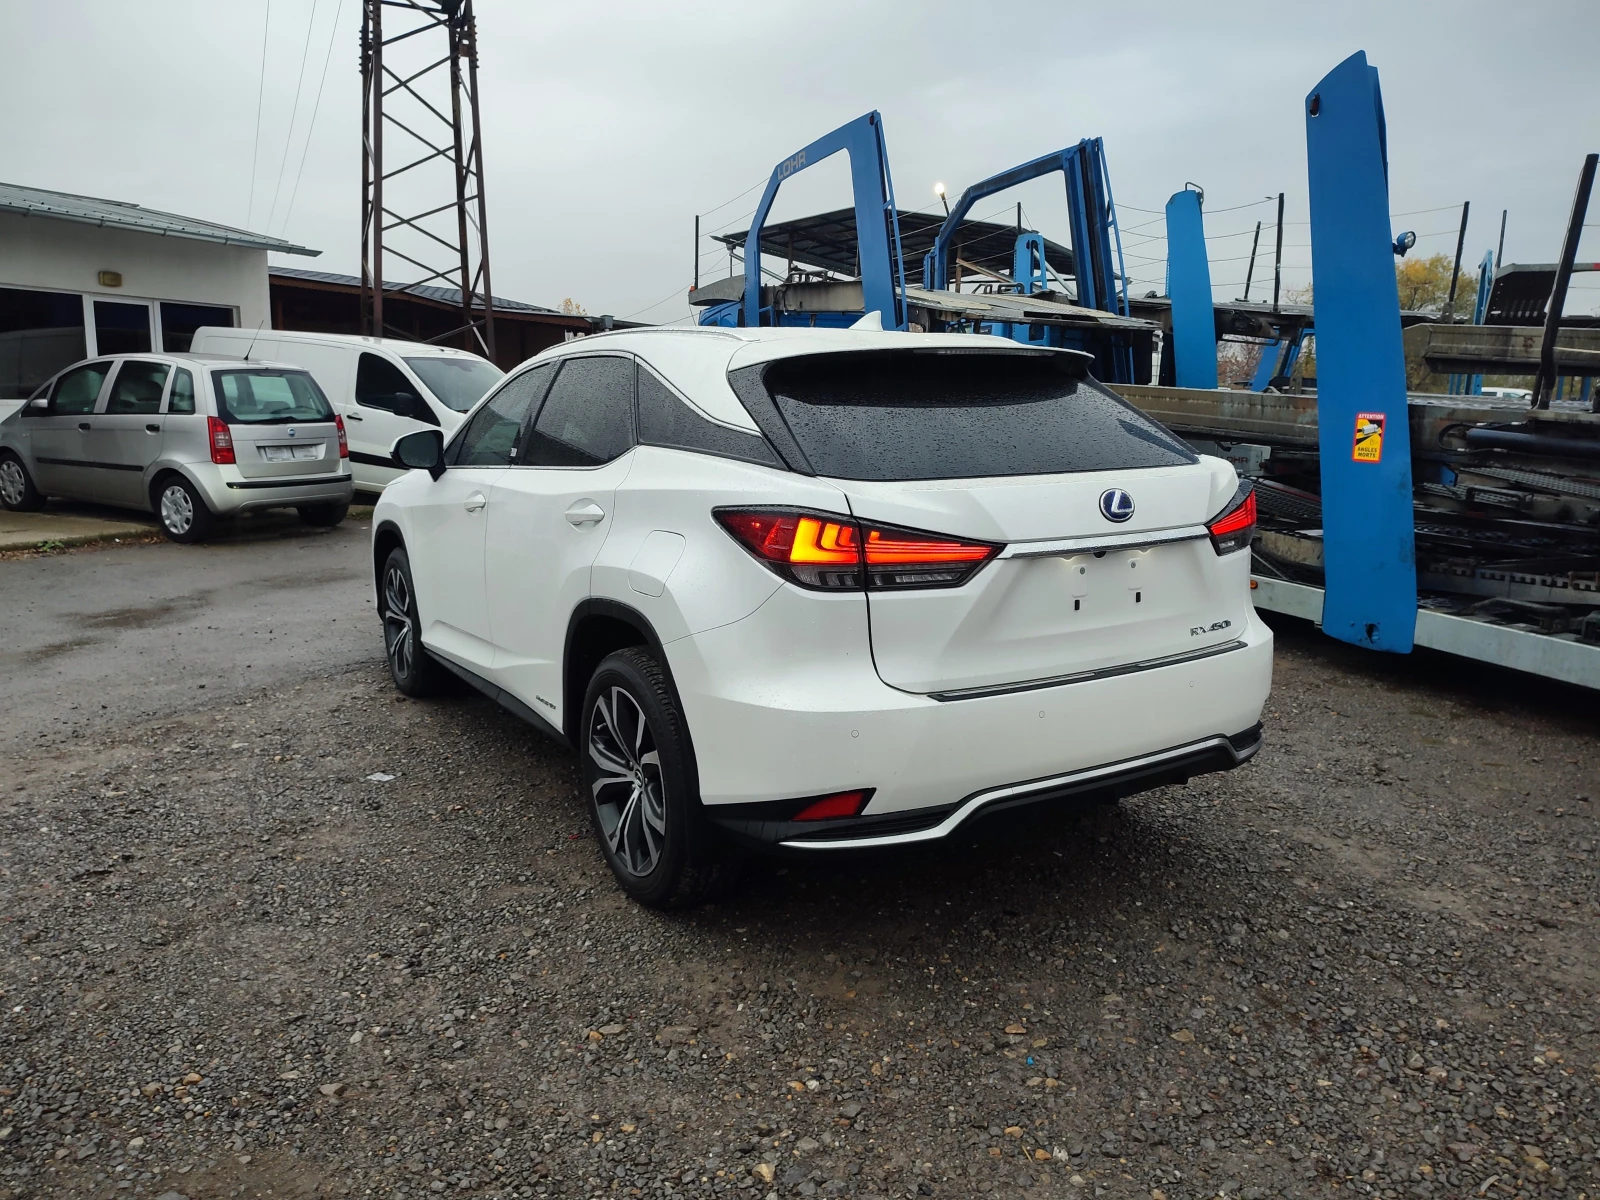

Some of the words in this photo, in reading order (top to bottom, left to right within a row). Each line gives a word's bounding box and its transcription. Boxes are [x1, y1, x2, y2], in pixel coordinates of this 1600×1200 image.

[776, 150, 806, 181] LOHR
[1220, 456, 1249, 465] OHR
[1190, 626, 1207, 637] RX
